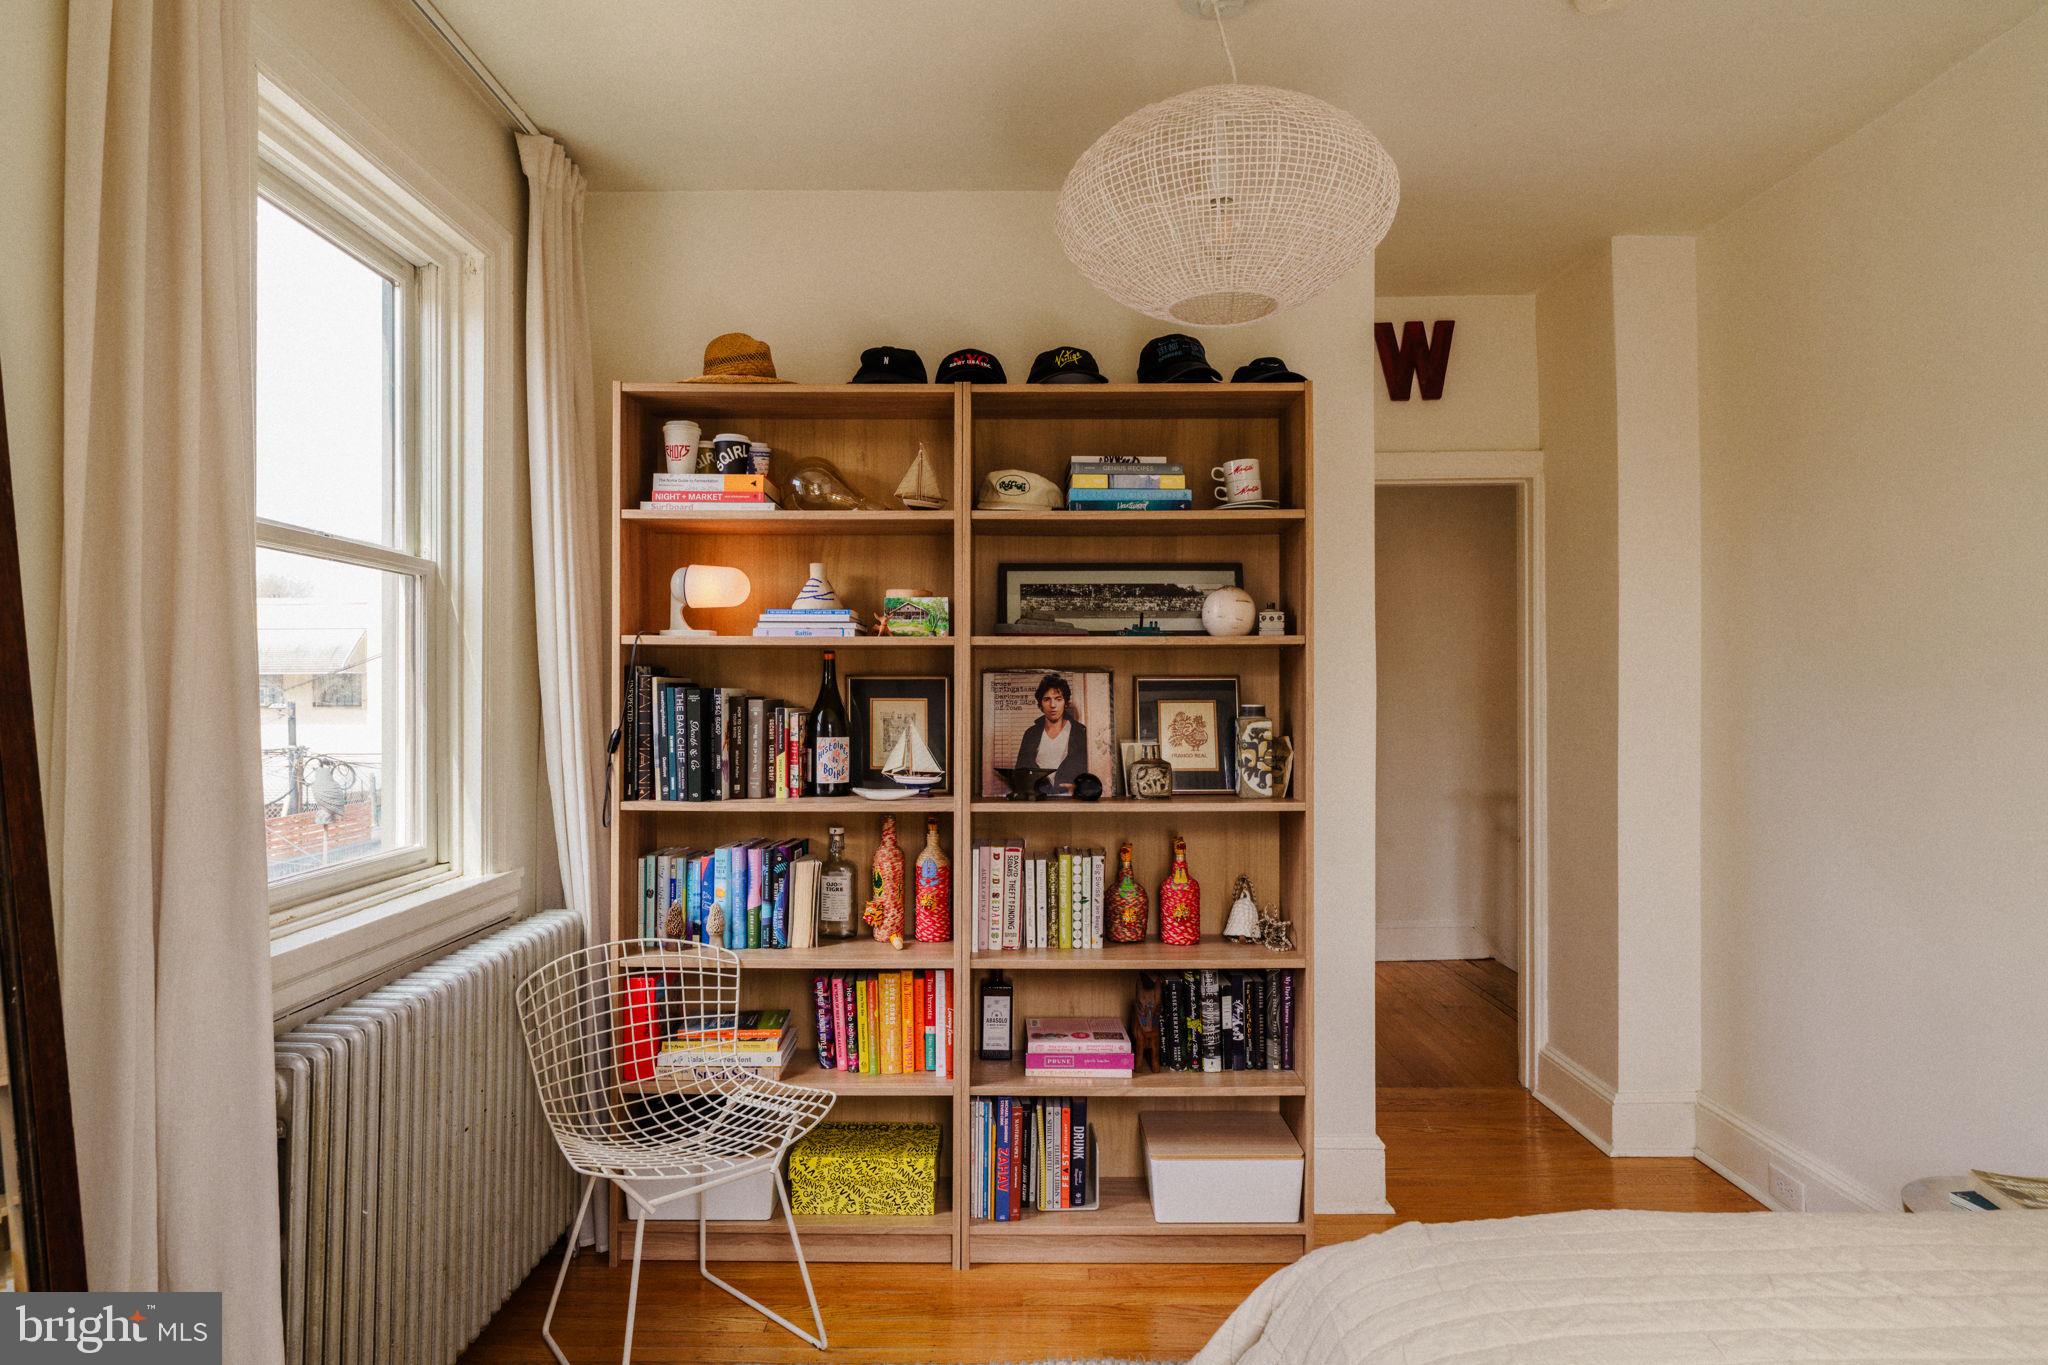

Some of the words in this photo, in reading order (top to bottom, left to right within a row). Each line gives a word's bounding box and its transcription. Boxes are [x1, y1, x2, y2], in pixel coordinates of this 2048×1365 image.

[883, 356, 889, 365] N
[1374, 320, 1455, 401] W
[716, 444, 748, 472] SQIRL
[651, 503, 694, 511] Surfboard
[676, 692, 684, 711] THE
[689, 720, 699, 746] Death
[677, 737, 685, 763] CHEF
[823, 763, 845, 780] BOIRE
[1094, 864, 1102, 875] Big
[1008, 880, 1017, 899] THEFT
[1008, 905, 1016, 930] FINDING
[816, 982, 824, 1006] UNTAMED
[1073, 1126, 1085, 1159] DRUNK
[997, 1147, 1009, 1192] ZAHAV
